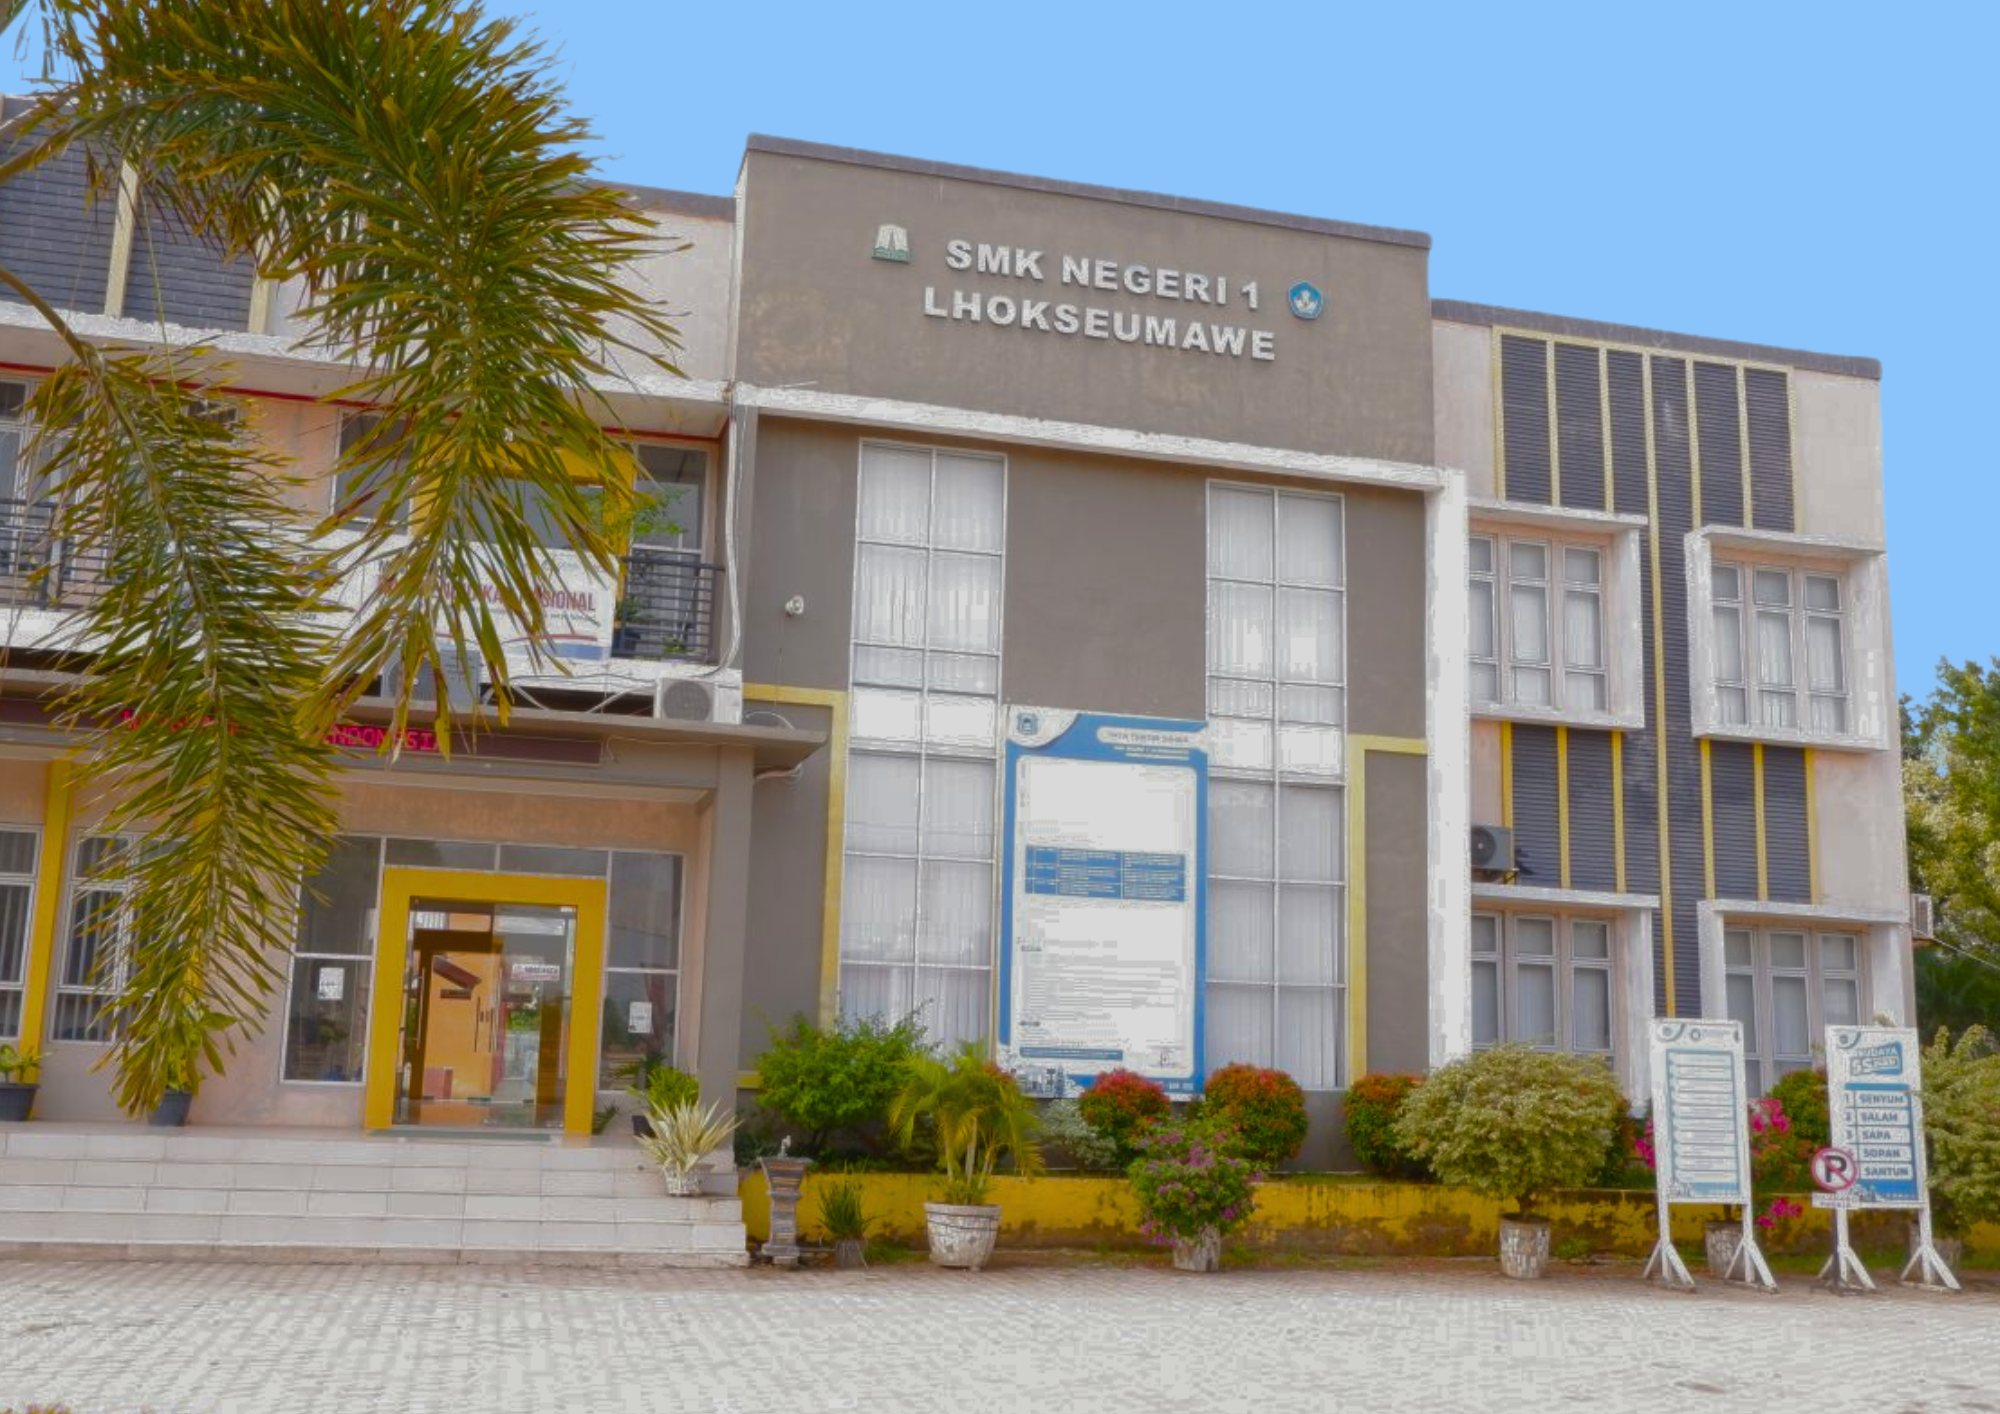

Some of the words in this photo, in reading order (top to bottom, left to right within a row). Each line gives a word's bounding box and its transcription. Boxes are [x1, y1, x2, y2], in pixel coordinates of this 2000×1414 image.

[945, 239, 1044, 279] SMK
[1061, 253, 1227, 305] NEGERI
[1241, 281, 1258, 310] 1
[922, 286, 1276, 361] LHOKSEUMAWE
[1859, 1093, 1903, 1104] SENYUM
[1860, 1111, 1898, 1122] SALAM
[1862, 1129, 1891, 1140] SAPA
[1863, 1148, 1901, 1158] SOPAN
[1865, 1166, 1908, 1176] SANTUN
